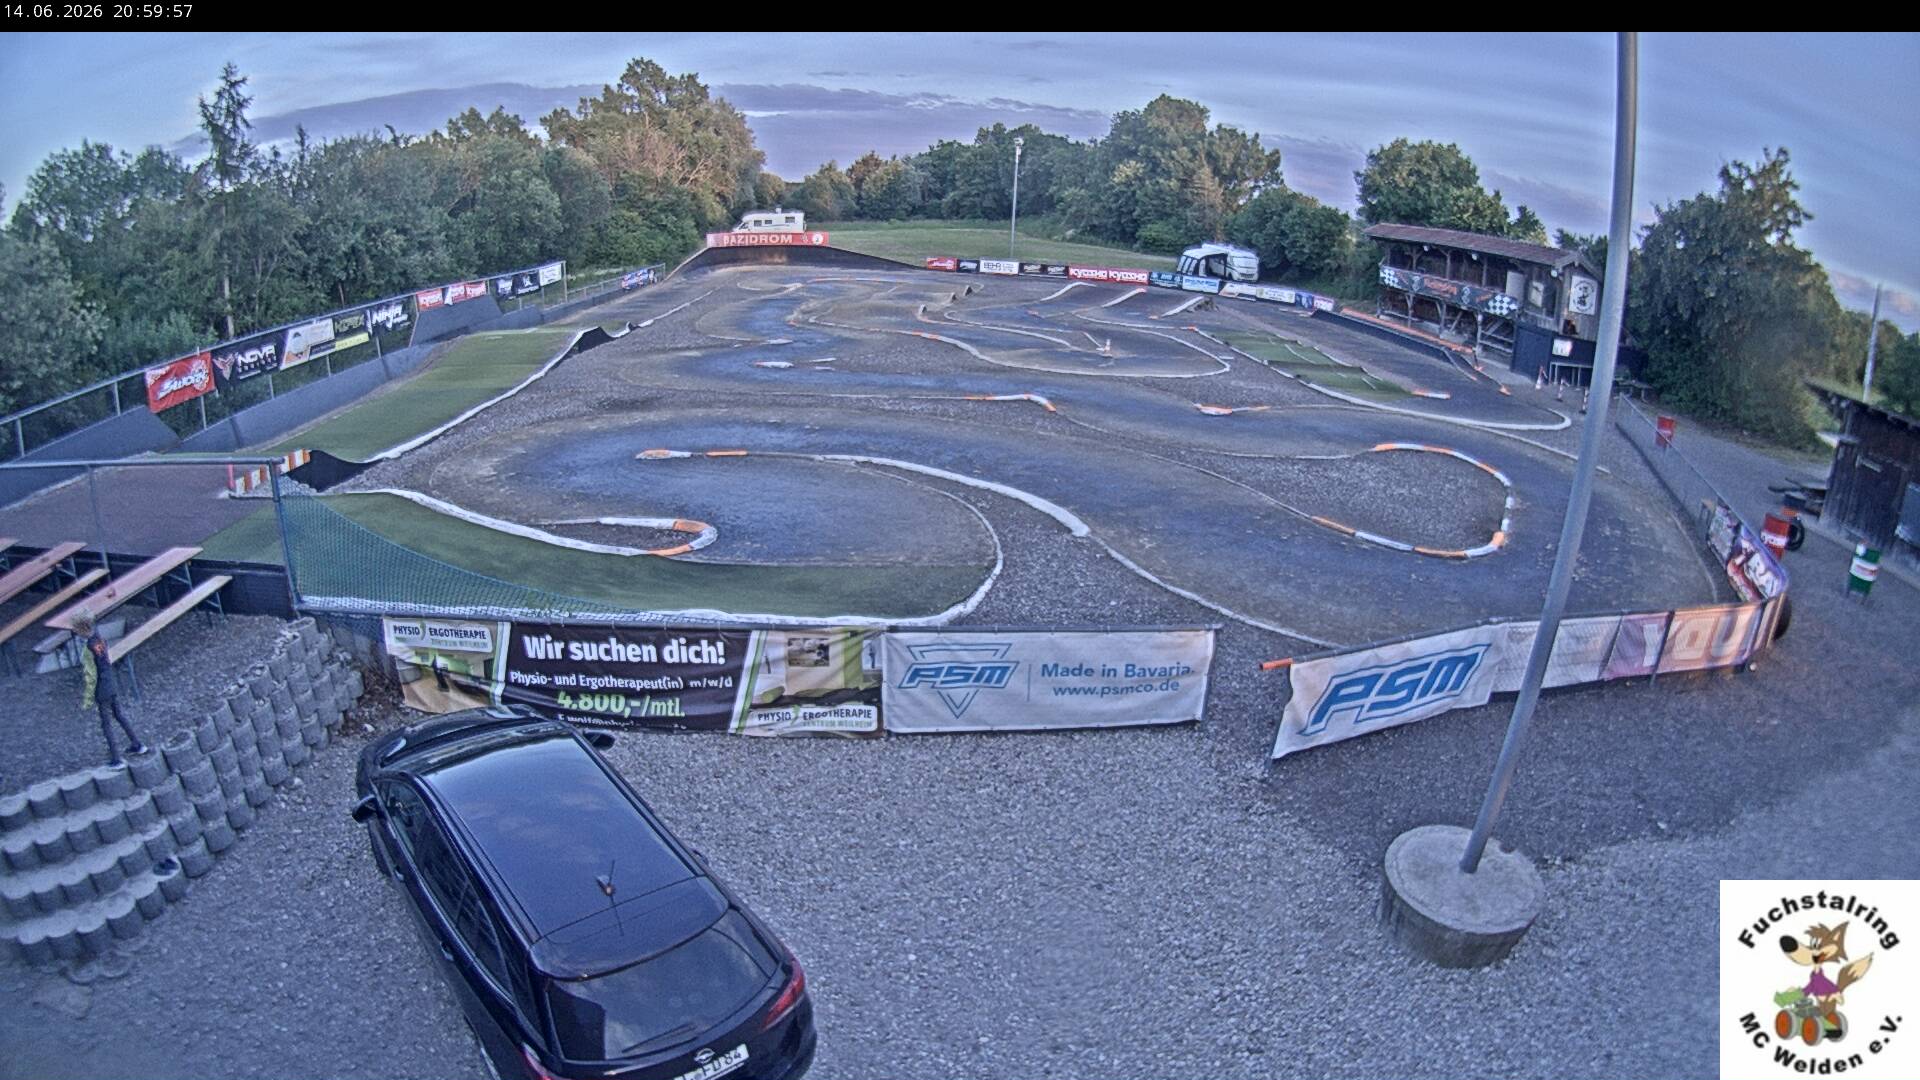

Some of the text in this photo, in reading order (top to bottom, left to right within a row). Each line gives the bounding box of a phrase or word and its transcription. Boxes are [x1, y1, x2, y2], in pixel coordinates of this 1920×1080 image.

[723, 234, 793, 245] BAZIDROM
[392, 624, 488, 640] PHYSIO ERGOTHERAPIE
[523, 634, 726, 665] Wir suchen dich!
[905, 664, 1012, 687] PSM
[1041, 663, 1095, 679] Made
[1101, 663, 1117, 679] in
[510, 671, 733, 690] Physio- und Ergotherapeut(in) m/w/d
[1052, 680, 1181, 698] www.psmco.de
[1308, 651, 1480, 727] PSM
[757, 708, 873, 722] PHYSIO ERGOTHERAPIE
